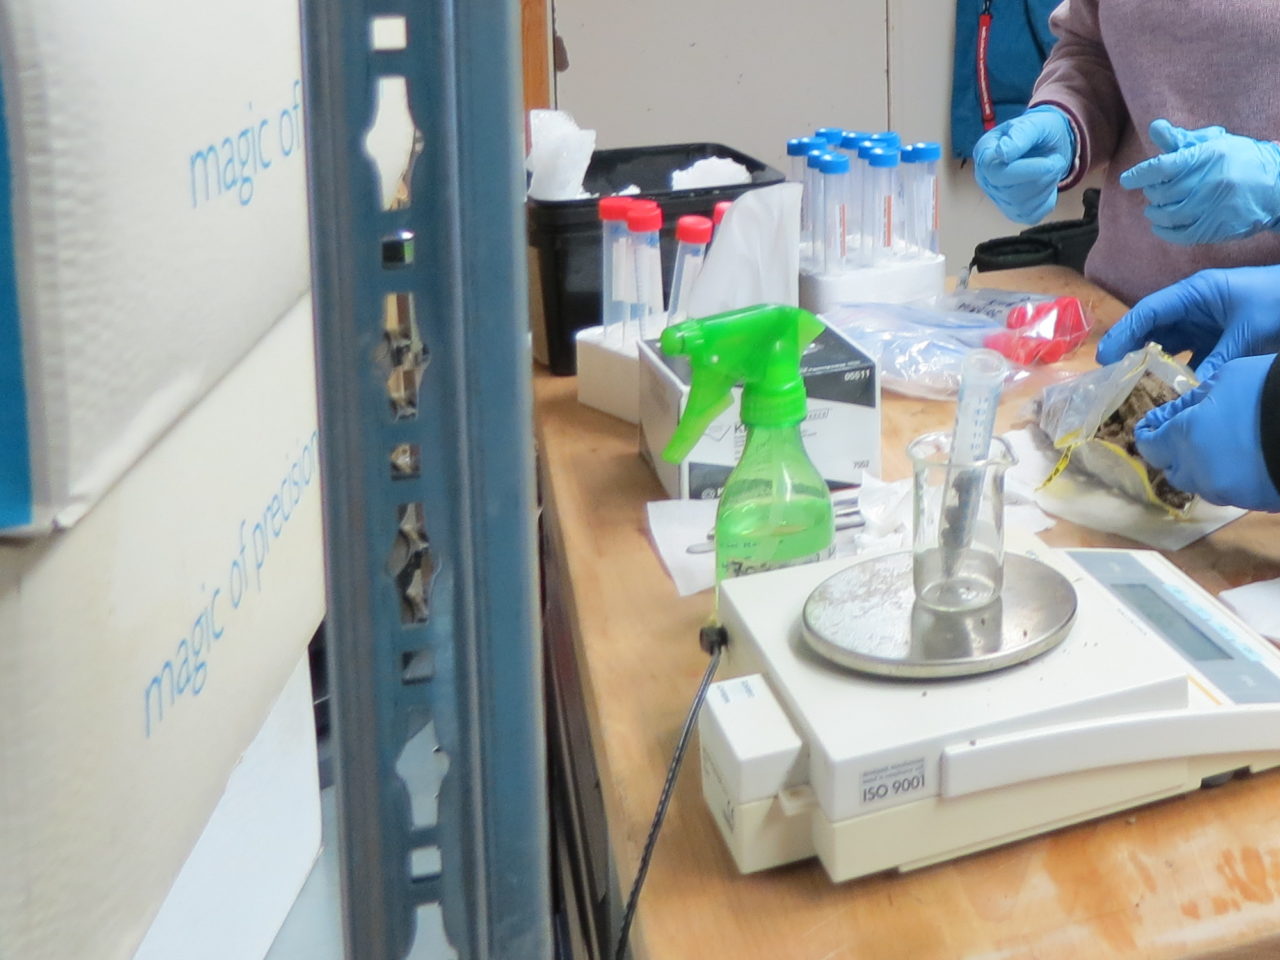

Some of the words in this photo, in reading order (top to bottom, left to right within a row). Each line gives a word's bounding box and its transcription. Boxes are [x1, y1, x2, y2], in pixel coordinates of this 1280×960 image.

[189, 100, 272, 208] magic
[279, 79, 301, 157] of
[143, 582, 224, 739] magic
[229, 517, 248, 609] of
[252, 430, 319, 593] precision
[863, 783, 889, 803] ISO
[892, 774, 926, 795] 9001
